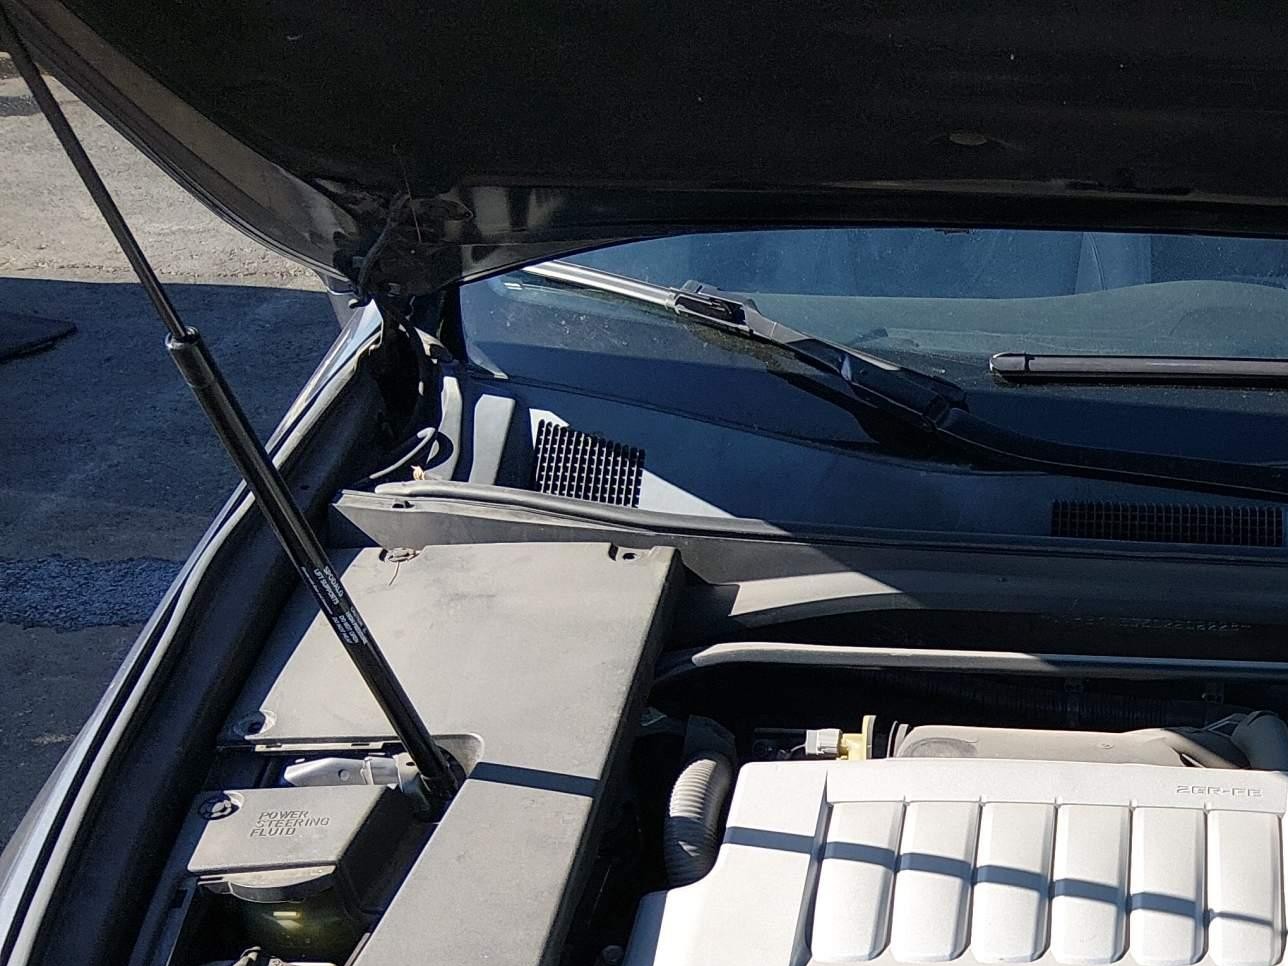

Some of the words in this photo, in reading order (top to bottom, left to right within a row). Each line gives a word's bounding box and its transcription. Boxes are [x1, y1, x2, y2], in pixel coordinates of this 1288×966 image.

[259, 810, 309, 820] POWER
[256, 817, 330, 828] STEERING
[250, 827, 296, 837] FLUID
